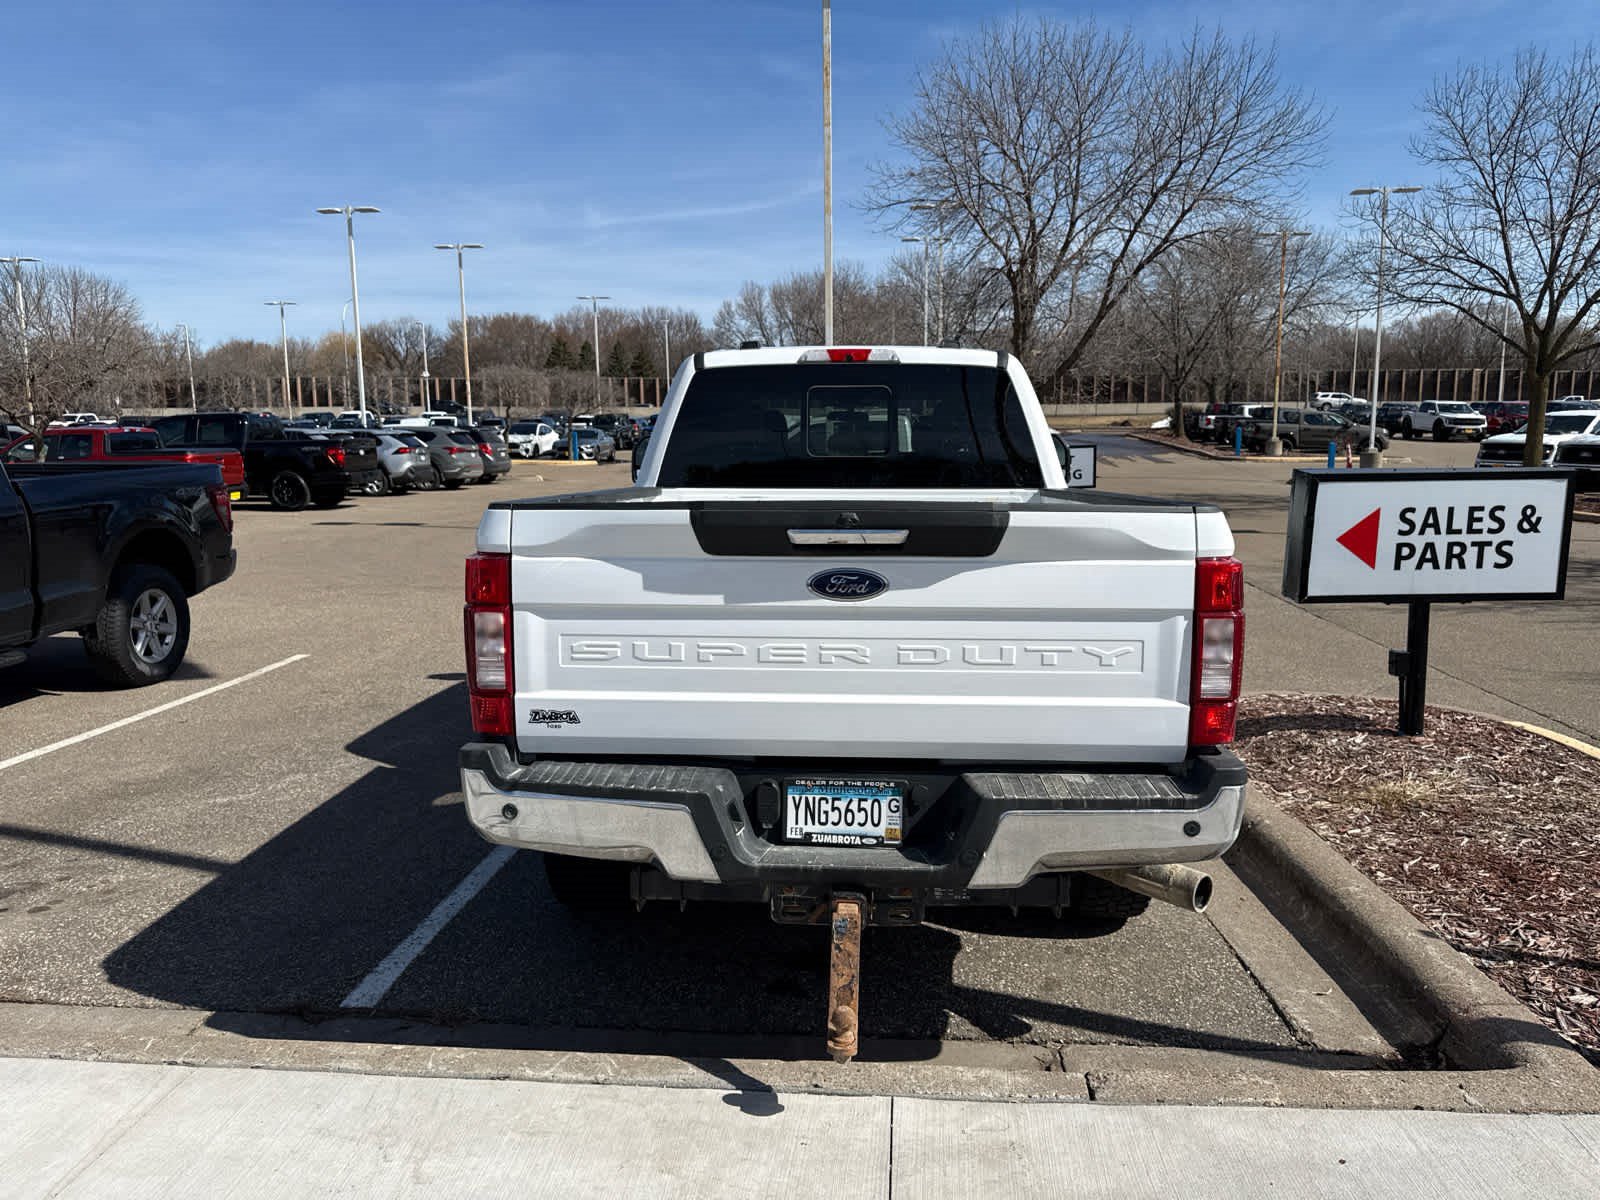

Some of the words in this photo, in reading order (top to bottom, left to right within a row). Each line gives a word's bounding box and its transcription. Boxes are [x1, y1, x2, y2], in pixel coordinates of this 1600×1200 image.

[1397, 505, 1506, 536] SALES
[1517, 504, 1542, 534] &
[1393, 540, 1514, 571] PARTS
[825, 575, 870, 593] Ford
[570, 640, 871, 666] SUPER
[896, 642, 1136, 668] DUTY
[529, 710, 580, 723] ZUMBROTA
[791, 796, 882, 827] YNG5650
[888, 798, 900, 813] G
[790, 827, 803, 836] FEB
[811, 834, 861, 845] ZUMBROTA
